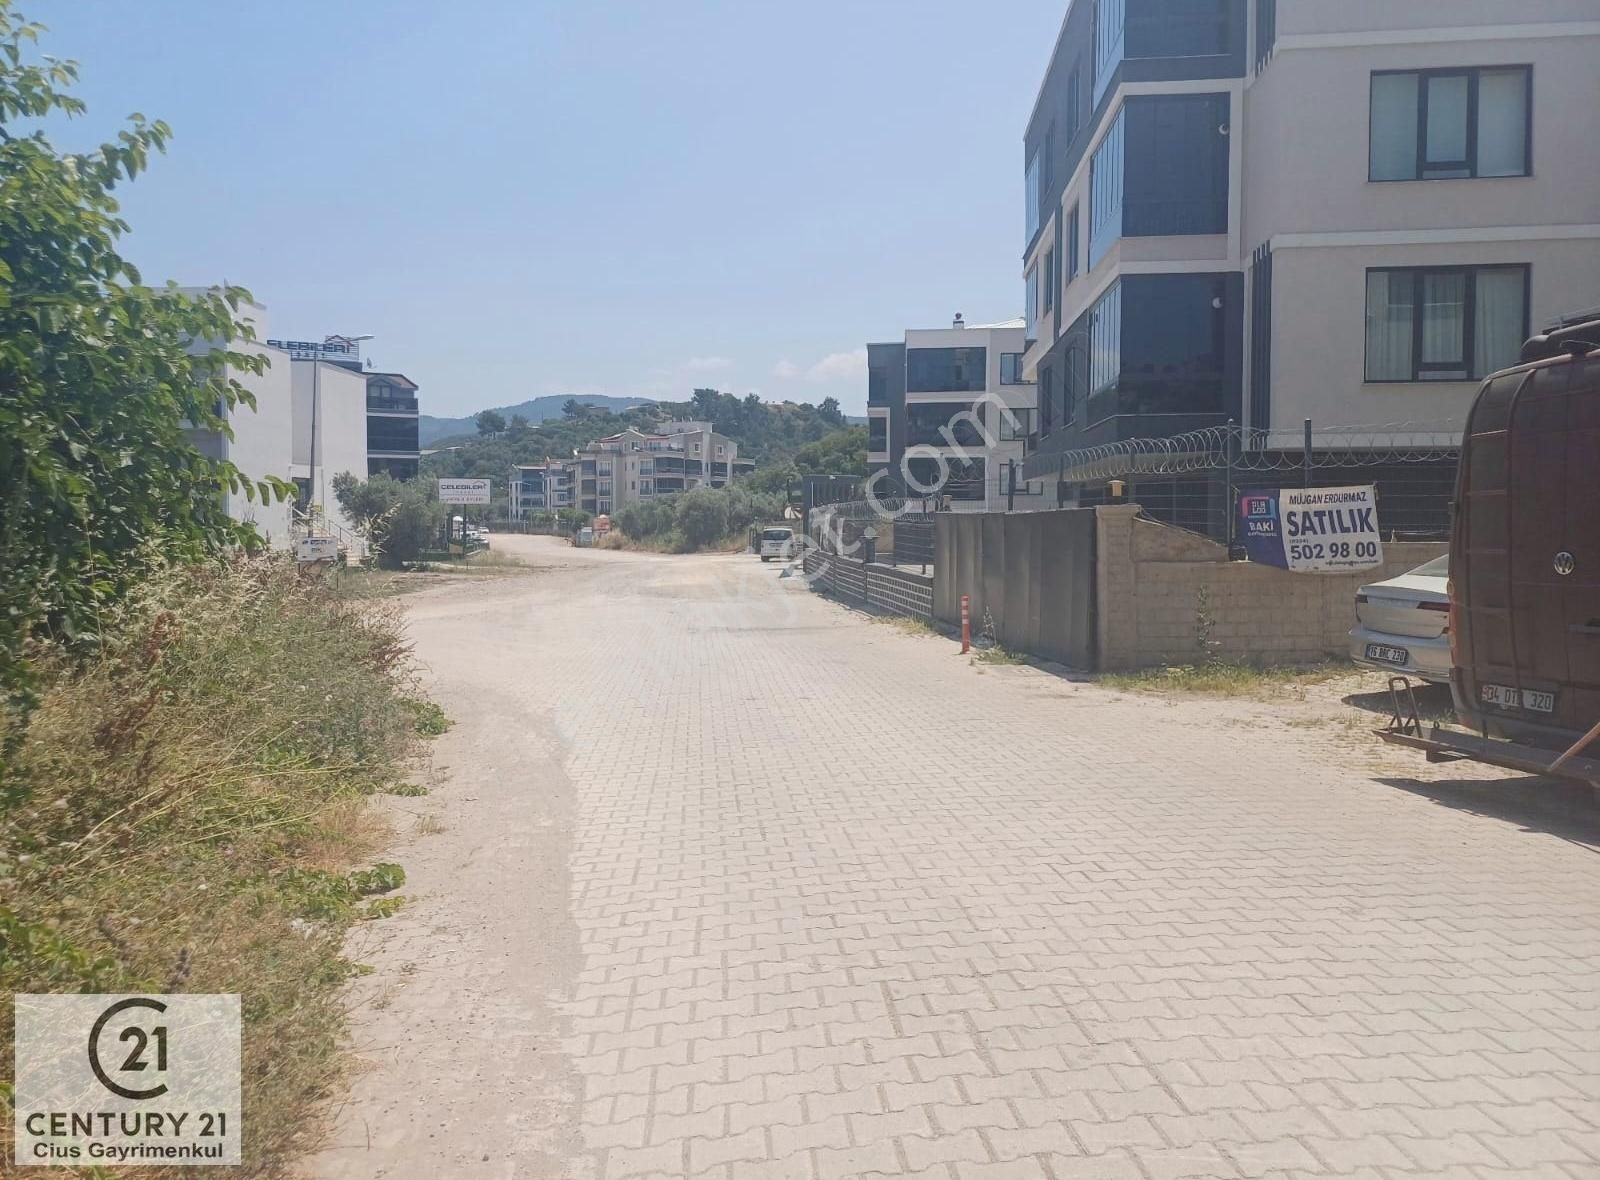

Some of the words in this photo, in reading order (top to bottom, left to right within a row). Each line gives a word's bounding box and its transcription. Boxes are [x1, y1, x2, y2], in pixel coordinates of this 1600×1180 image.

[1324, 492, 1367, 504] ERDURMAZ
[1287, 508, 1376, 537] SATILIK
[1291, 544, 1325, 560] 502
[1329, 542, 1350, 558] 98
[1356, 541, 1377, 558] 00
[1531, 693, 1552, 710] 320
